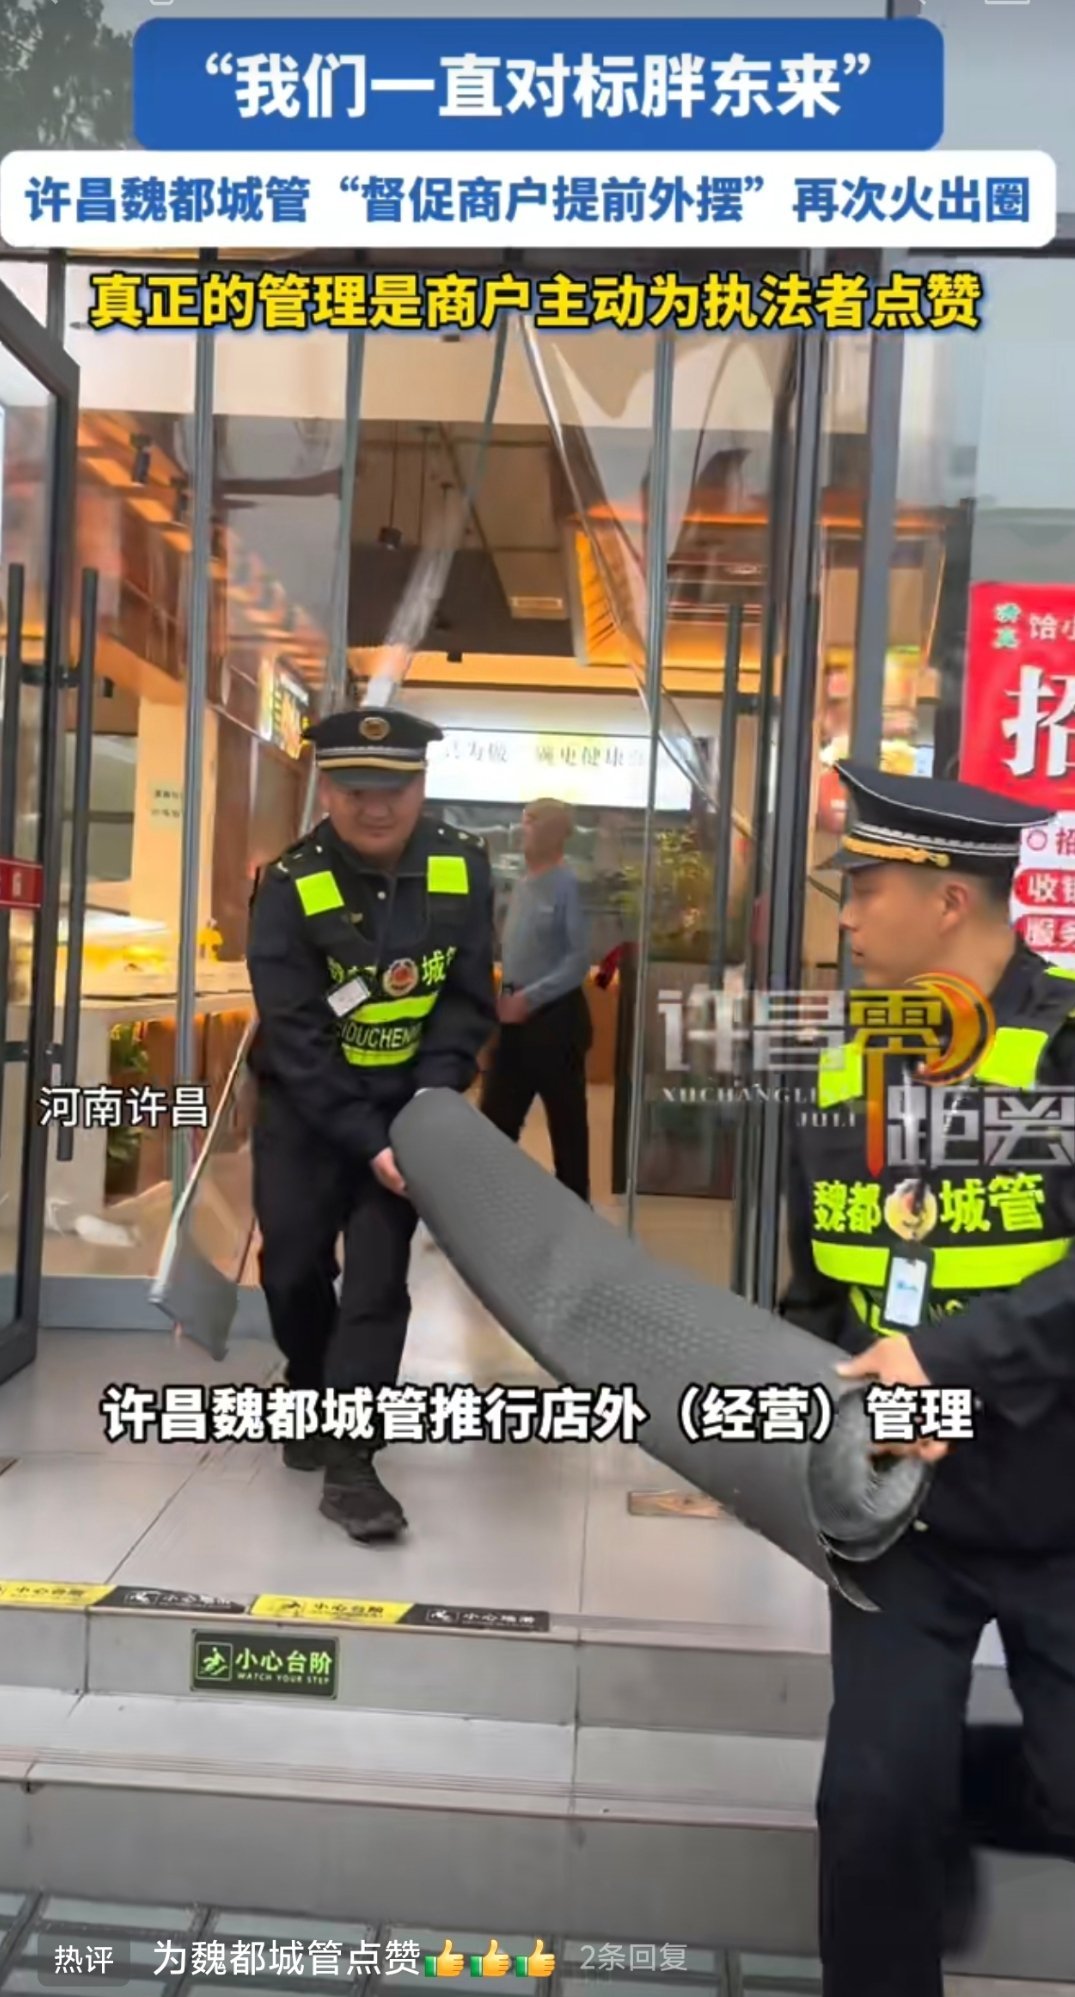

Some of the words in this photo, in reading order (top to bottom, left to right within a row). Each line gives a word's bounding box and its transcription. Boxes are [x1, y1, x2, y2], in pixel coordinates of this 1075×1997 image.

[235, 1648, 333, 1675] 小心台阶
[237, 1672, 273, 1681] WATCH
[277, 1675, 303, 1683] YOUR
[306, 1676, 331, 1685] STEP
